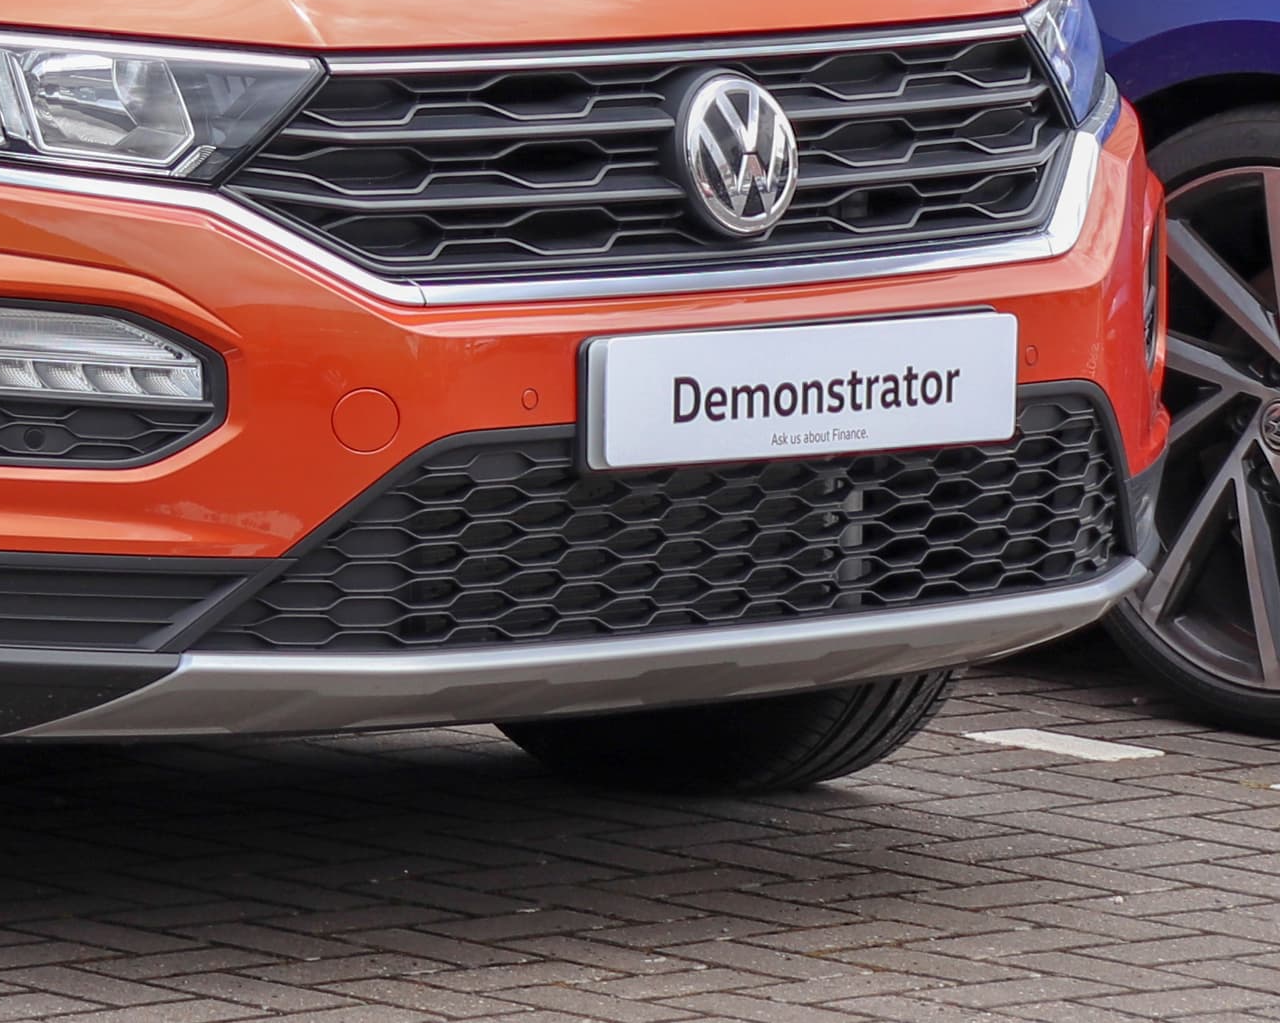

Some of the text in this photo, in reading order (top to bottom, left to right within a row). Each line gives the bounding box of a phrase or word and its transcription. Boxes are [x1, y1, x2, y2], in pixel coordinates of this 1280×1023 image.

[673, 365, 961, 424] Demonstrator
[771, 427, 869, 446] Ask us about Finance.
